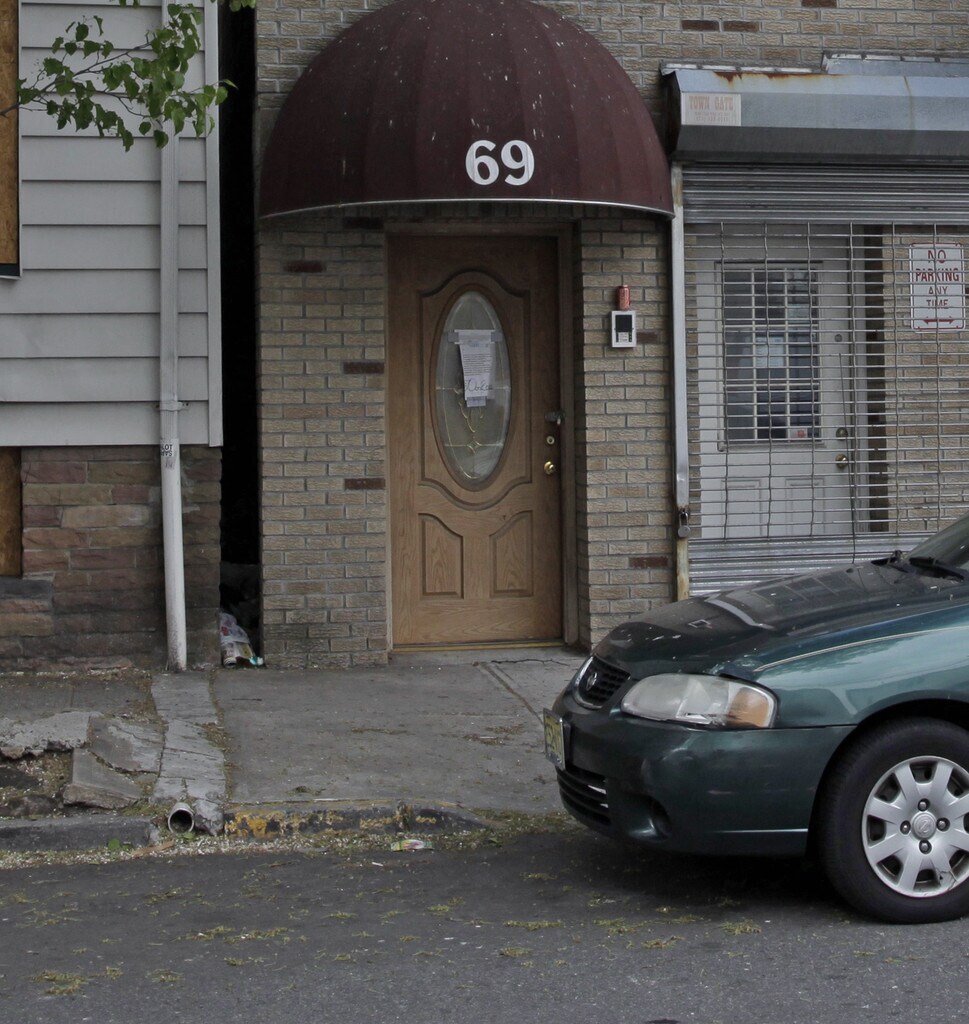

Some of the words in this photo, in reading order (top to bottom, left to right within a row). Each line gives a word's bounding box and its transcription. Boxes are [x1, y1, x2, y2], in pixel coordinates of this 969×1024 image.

[465, 139, 536, 186] 69
[928, 249, 947, 264] NO
[915, 268, 960, 282] PARKING
[928, 286, 948, 295] ANY
[926, 299, 949, 309] TIME
